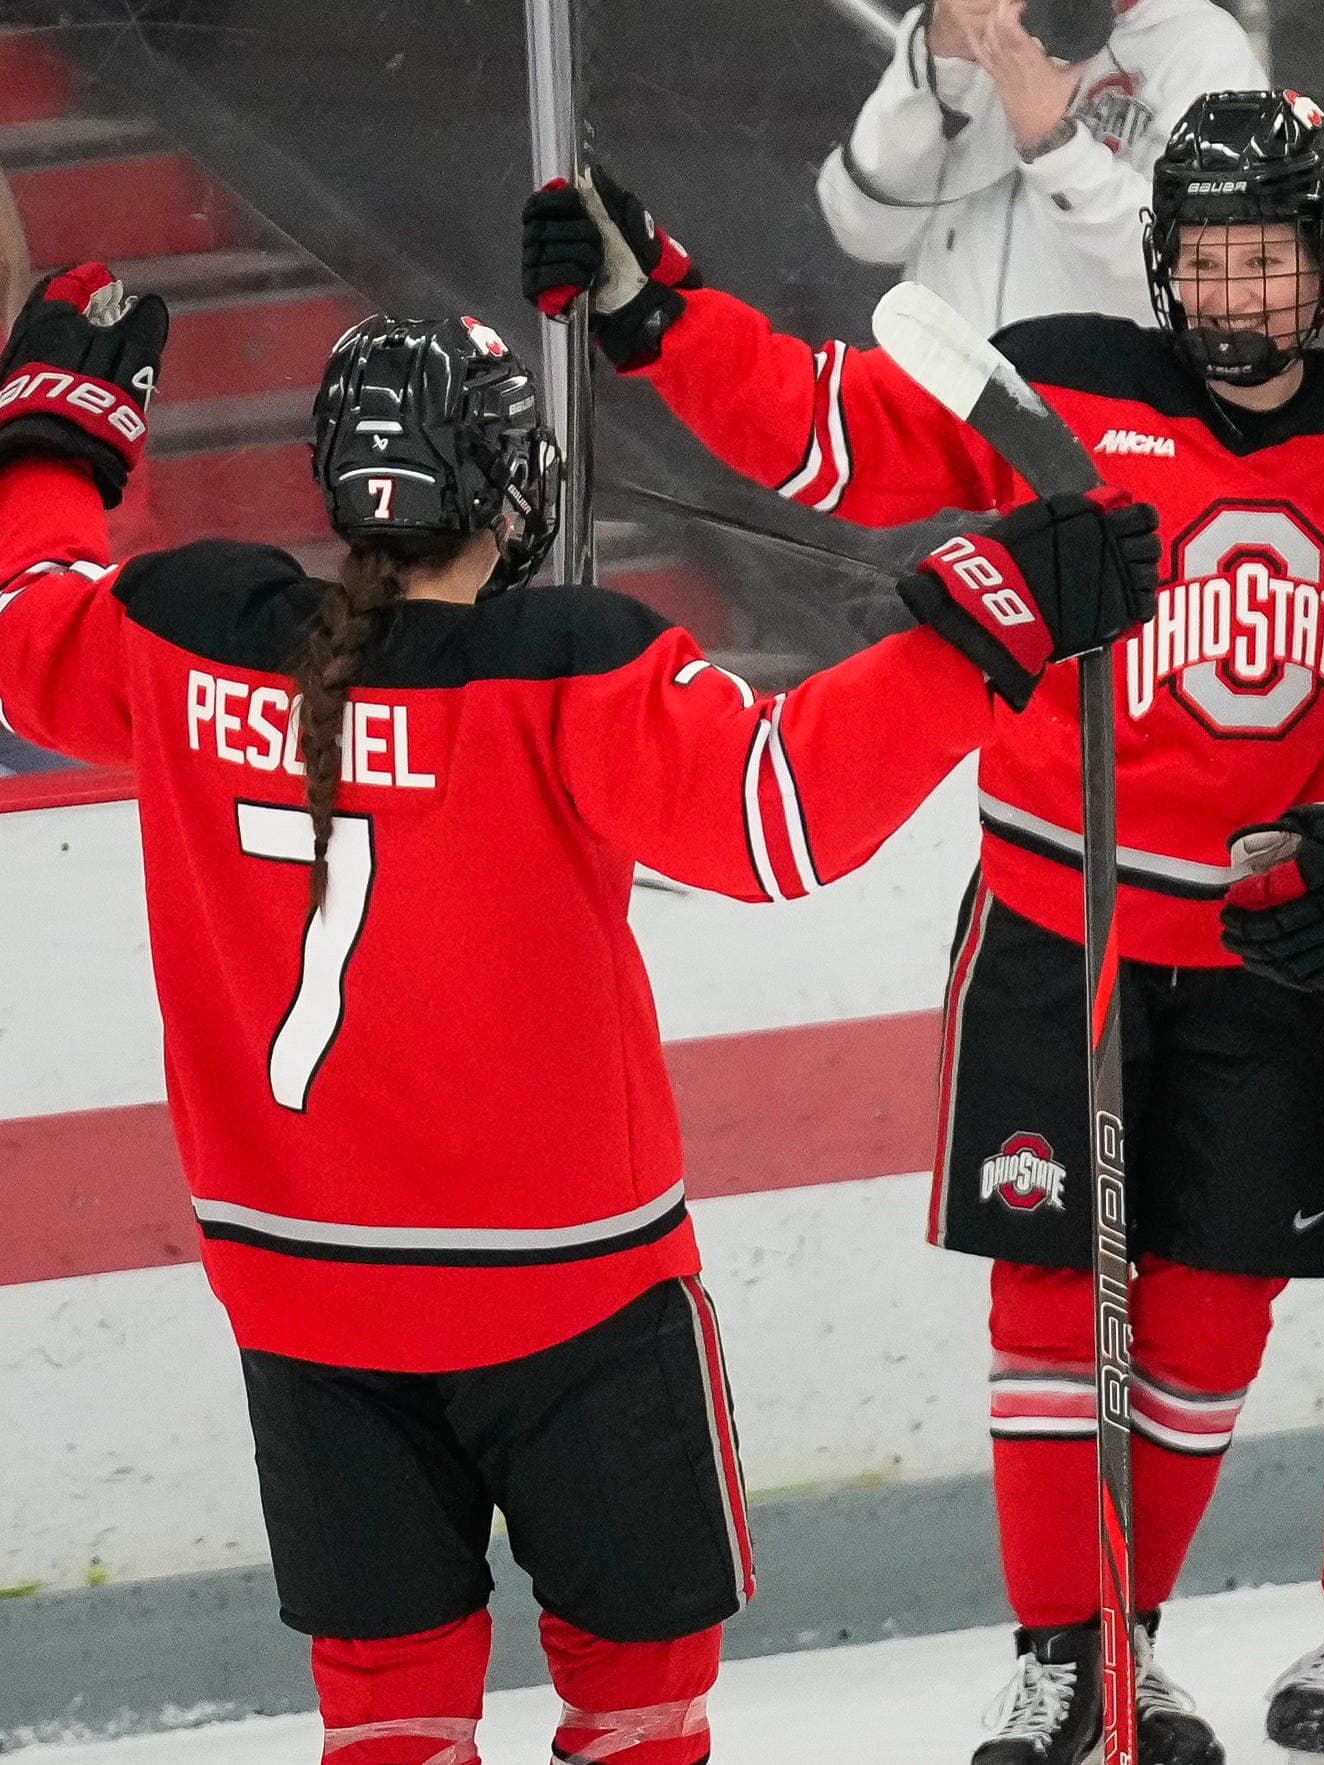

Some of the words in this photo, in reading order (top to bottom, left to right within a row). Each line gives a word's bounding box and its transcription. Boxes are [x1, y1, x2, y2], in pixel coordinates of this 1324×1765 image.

[1187, 180, 1248, 193] BAUER
[0, 372, 146, 442] BAUE
[367, 478, 394, 519] 7
[930, 536, 1037, 627] BAU
[233, 797, 376, 1114] 7
